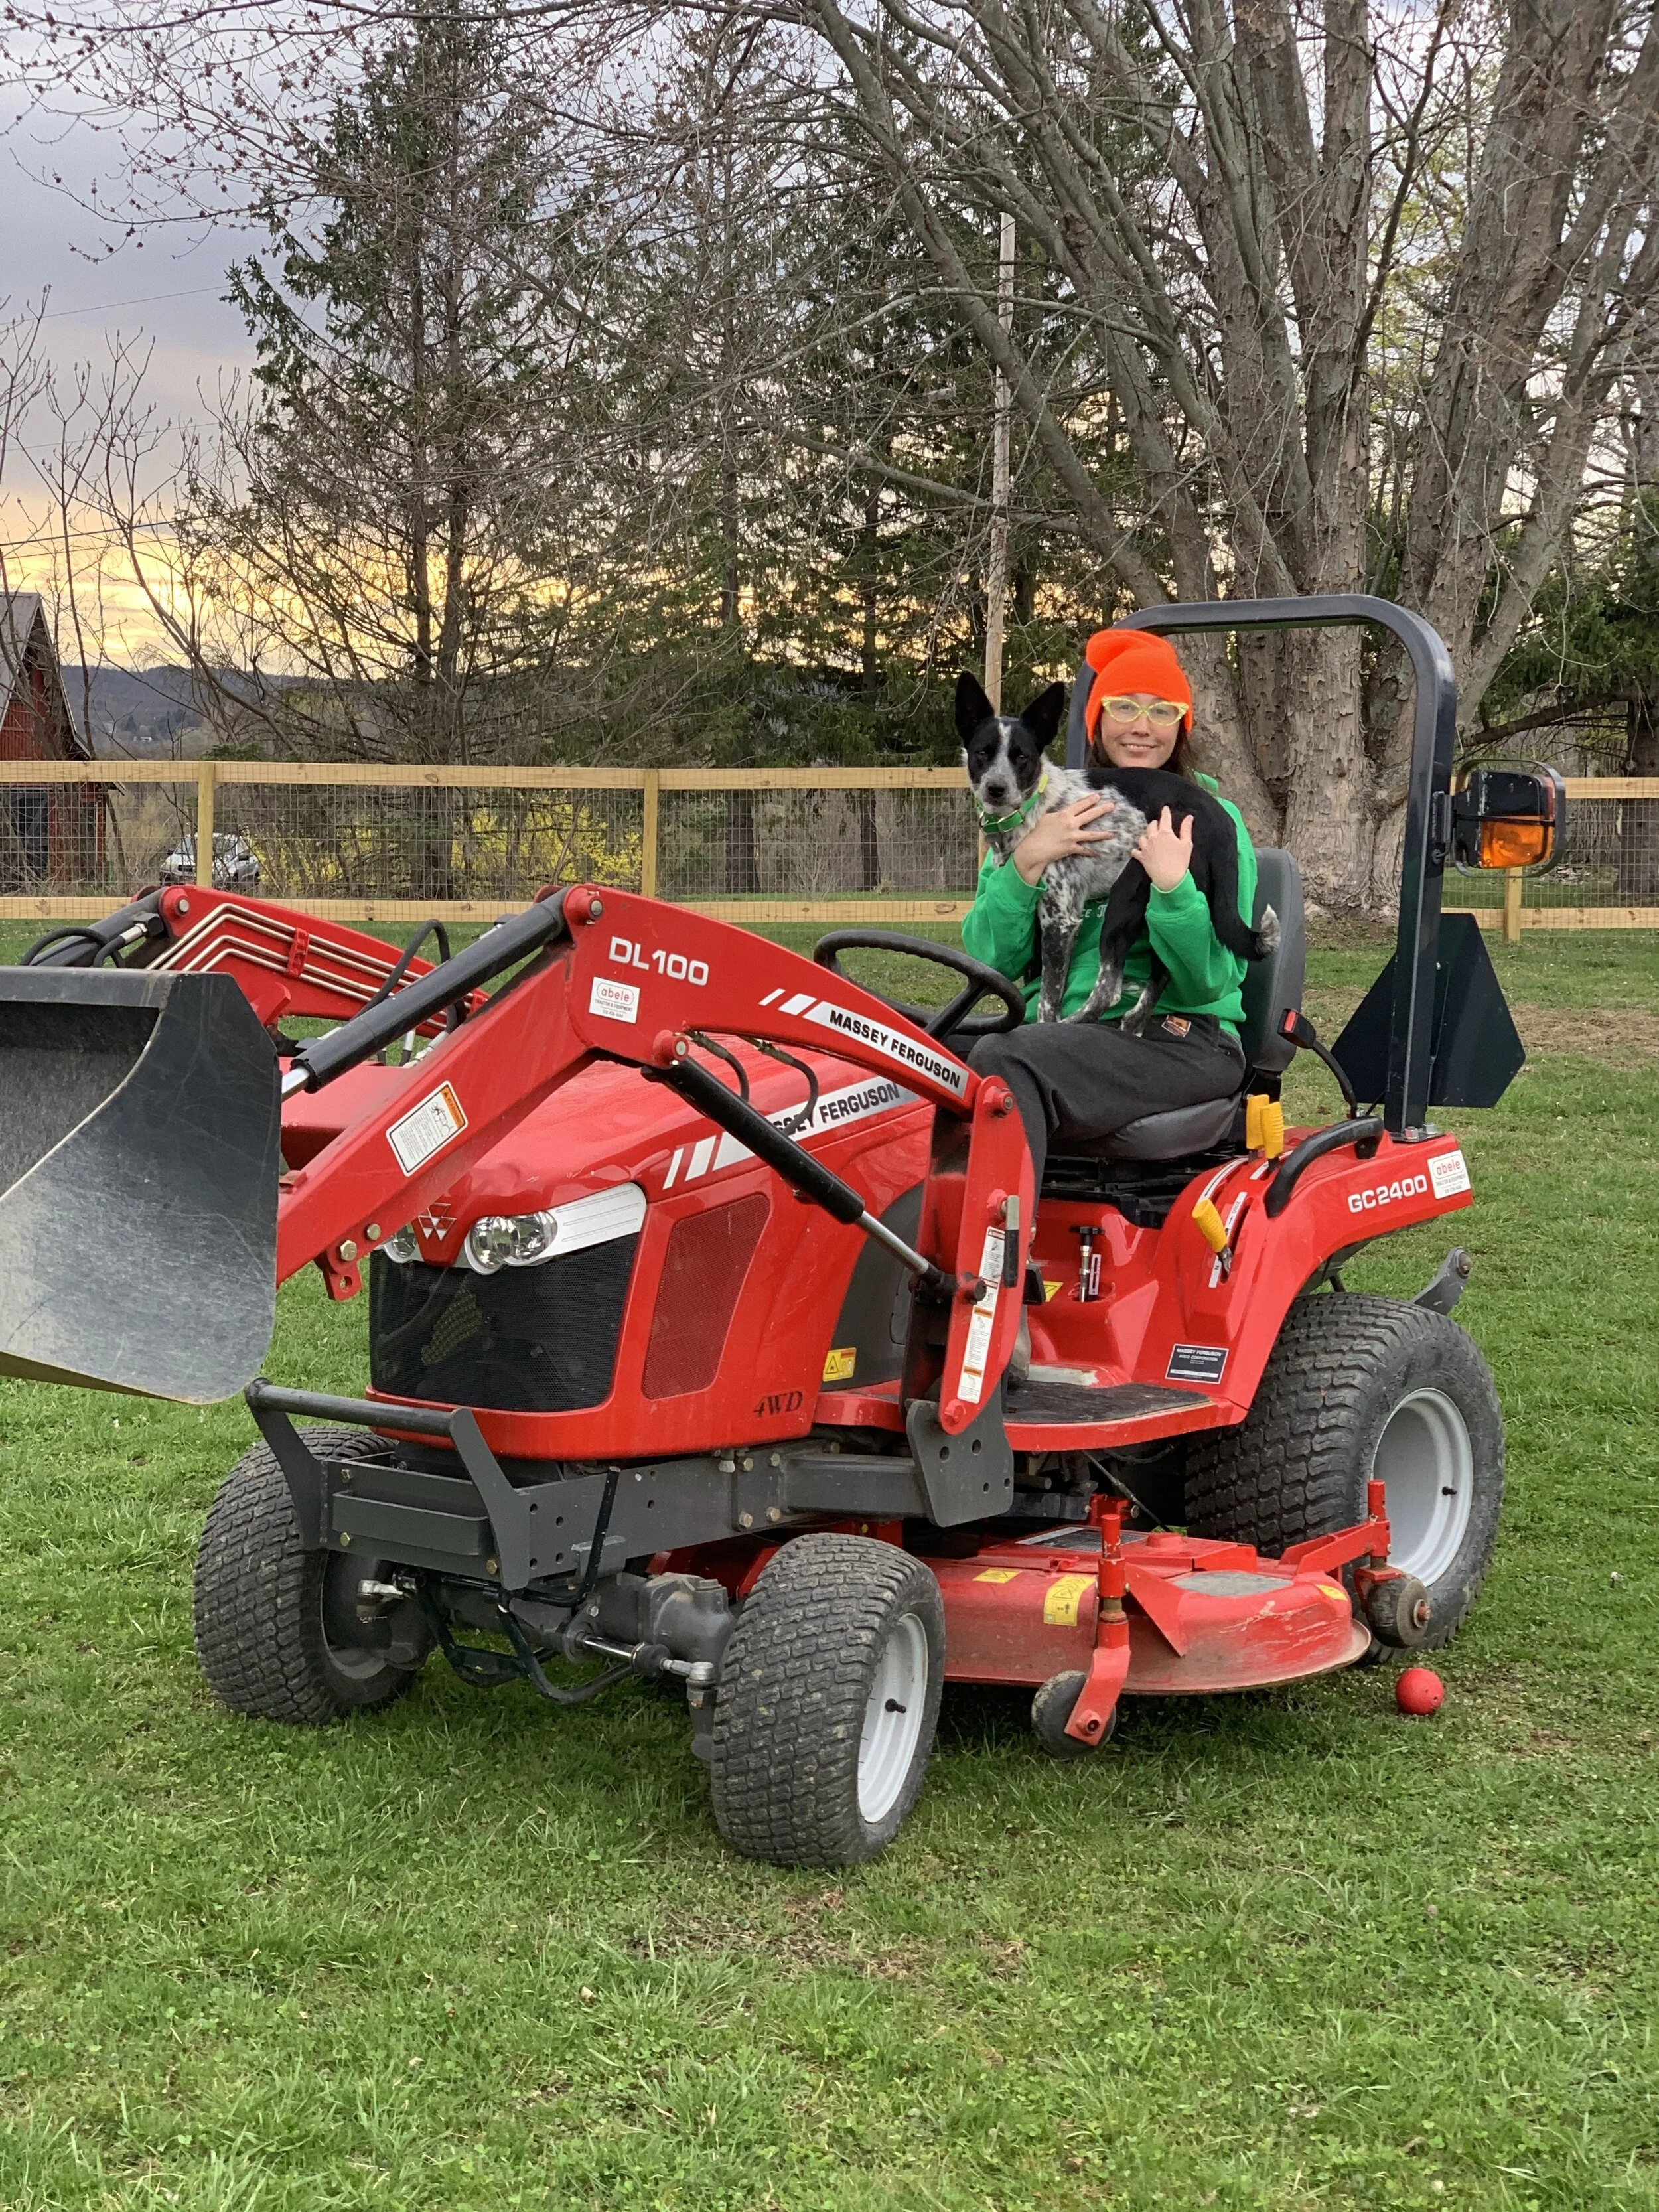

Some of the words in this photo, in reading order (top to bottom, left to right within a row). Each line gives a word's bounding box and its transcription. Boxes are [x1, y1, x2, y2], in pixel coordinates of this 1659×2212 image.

[609, 936, 709, 986] DL100
[601, 987, 630, 1002] abele
[830, 1010, 888, 1047] MASSEY
[891, 1039, 960, 1088] FERGUSON
[819, 1082, 900, 1124] FERGUSON
[1437, 1159, 1461, 1175] abele
[1348, 1175, 1428, 1213] GC2400
[753, 1390, 803, 1417] 4WD
